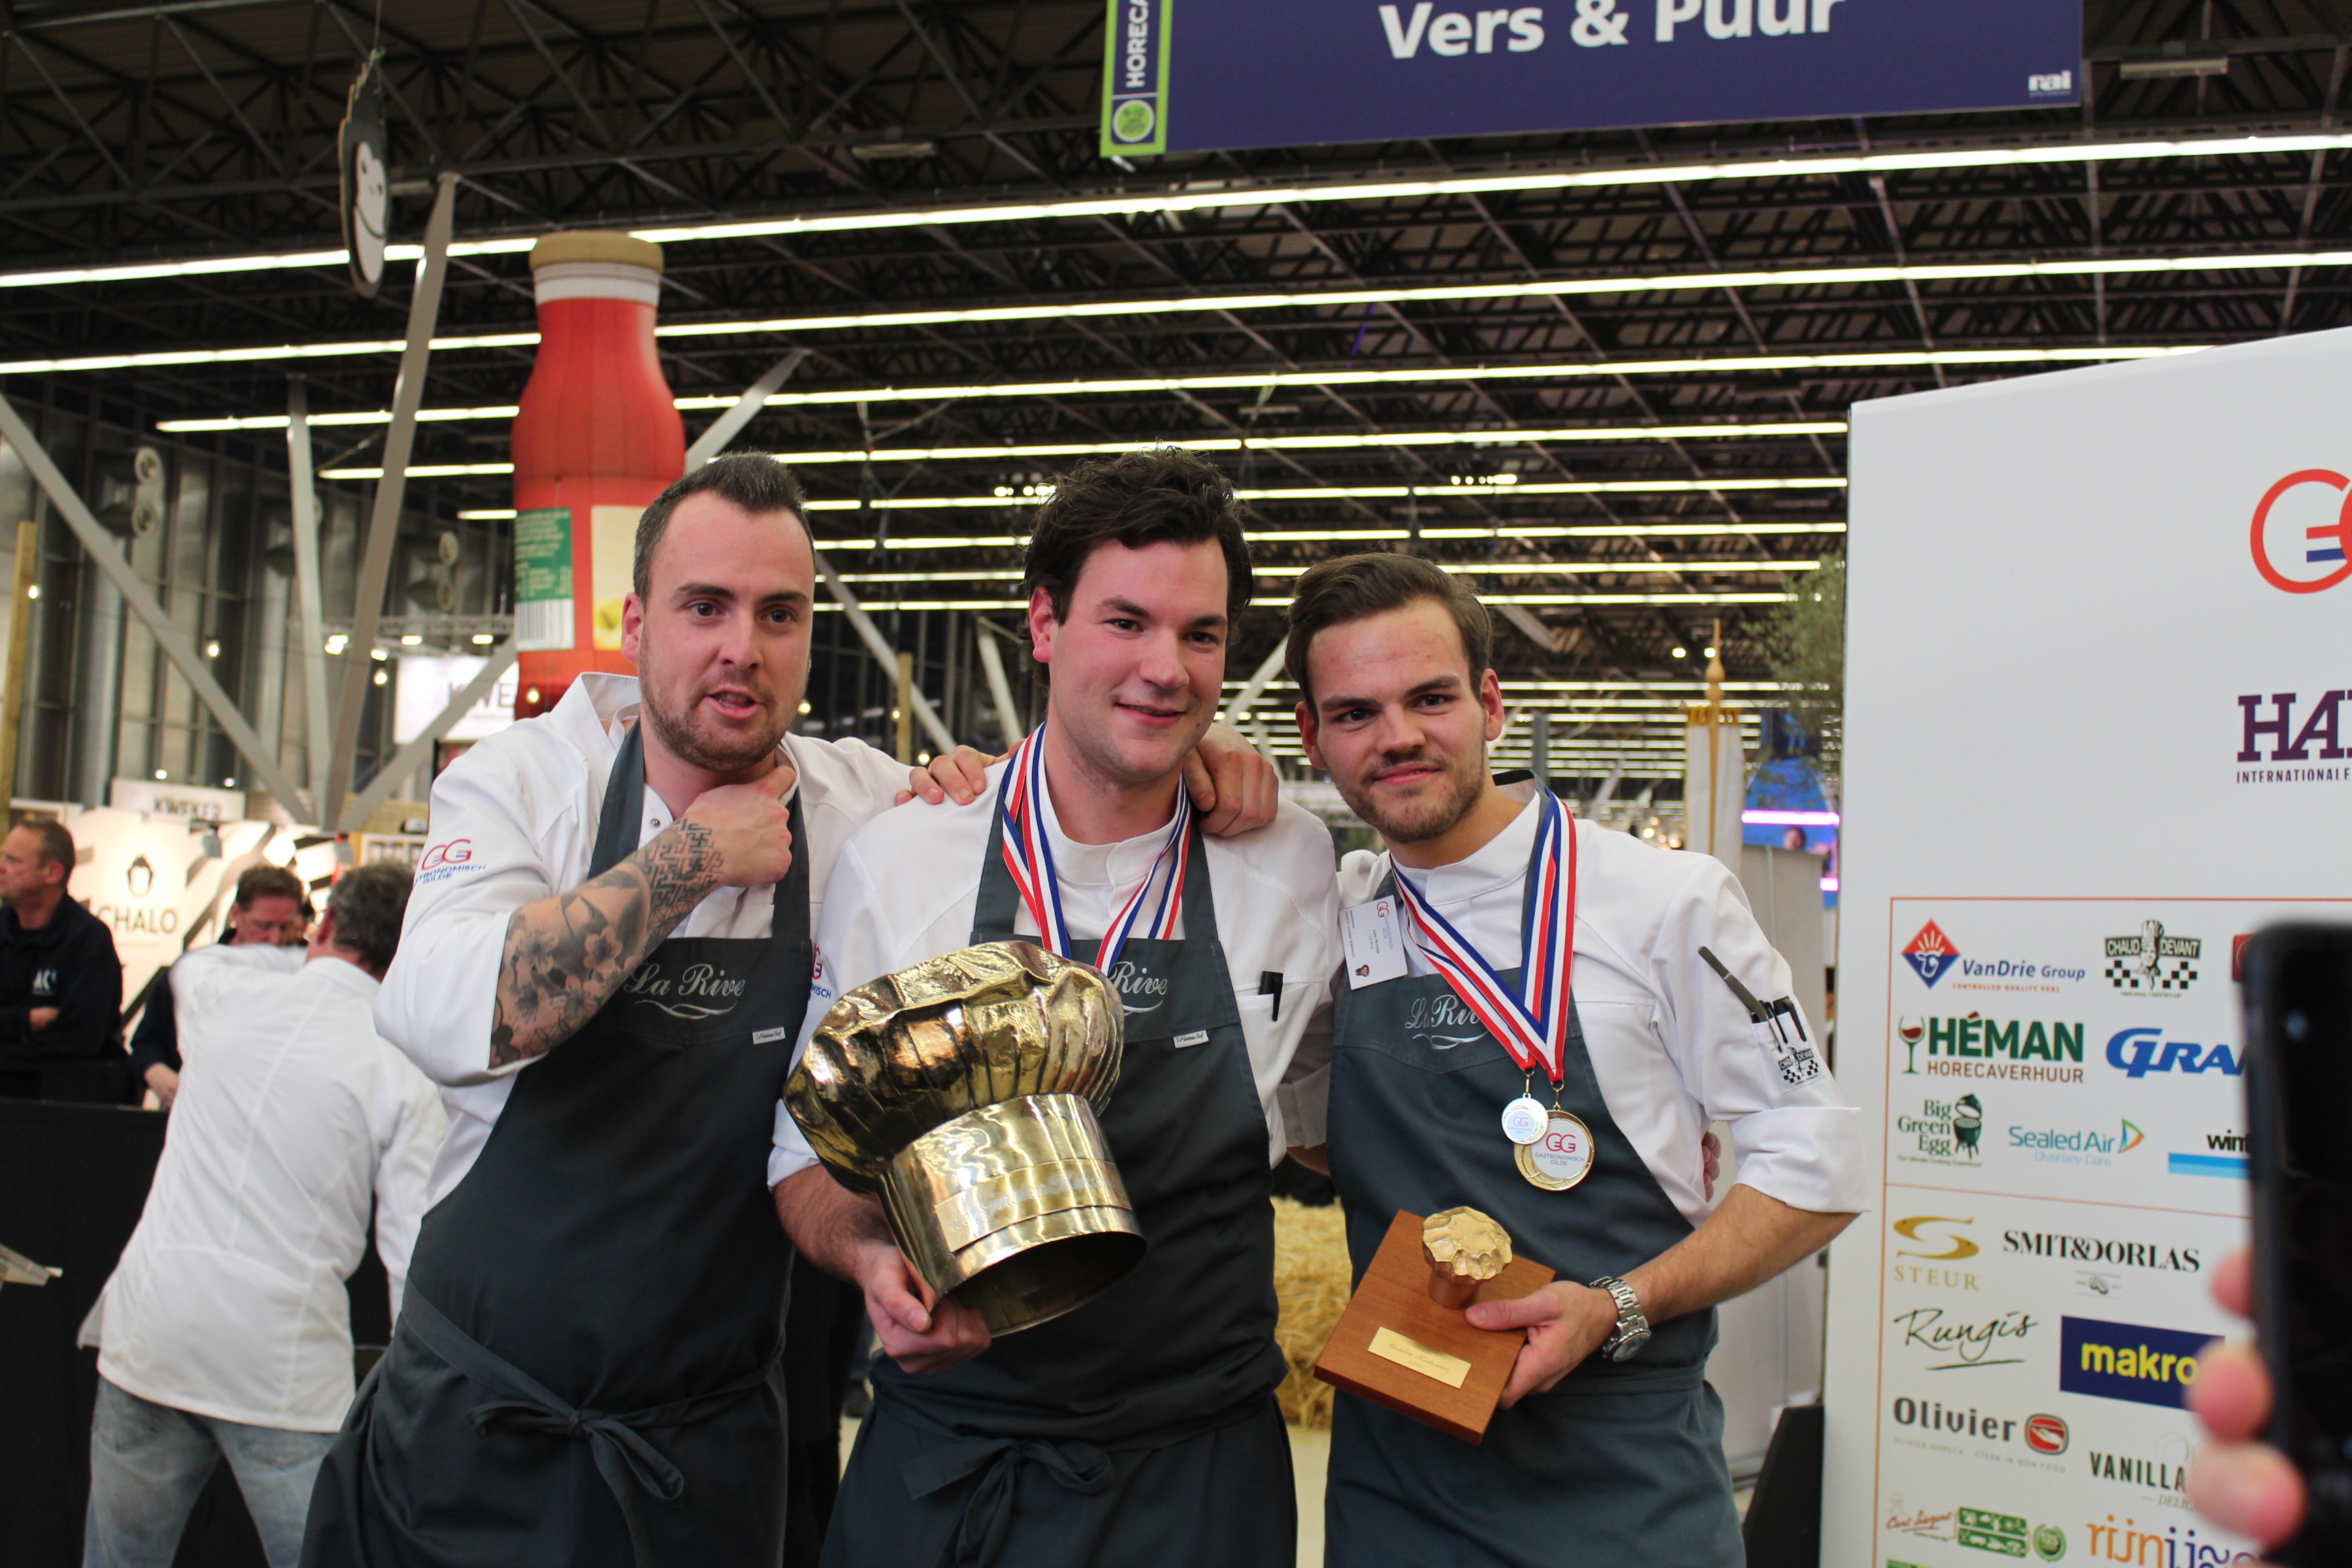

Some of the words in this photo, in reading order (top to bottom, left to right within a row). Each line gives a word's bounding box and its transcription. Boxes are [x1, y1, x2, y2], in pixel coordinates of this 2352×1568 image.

[1379, 1, 1545, 60] Vers
[1569, 0, 1629, 48] &
[1655, 0, 1838, 42] Puur
[2028, 69, 2072, 91] rai
[2238, 689, 2352, 764] HA
[2108, 939, 2140, 956] CHAUD
[2161, 939, 2200, 958] DEVANT
[623, 963, 671, 996] La
[679, 964, 746, 997] Rive
[1963, 960, 2036, 977] VanDrie
[2042, 965, 2086, 981] Group
[1928, 1012, 2084, 1062] HÉMAN
[1927, 1060, 2084, 1083] HORECAVERHUUR
[1923, 1099, 1952, 1122] Big
[1898, 1116, 1951, 1135] Green
[1546, 1132, 1576, 1153] GG
[1918, 1134, 1951, 1157] Egg
[2009, 1126, 2082, 1152] Sealed
[2085, 1132, 2116, 1154] Air
[1535, 1152, 1585, 1162] GASTRONOMISCH
[2034, 1150, 2081, 1166] Diversey
[2085, 1154, 2112, 1166] Care
[1894, 1264, 1980, 1291] STEUR
[1893, 1307, 2039, 1362] Rungis
[2081, 1342, 2199, 1386] makro
[1893, 1396, 2016, 1443] Olivier
[2090, 1451, 2187, 1493] VANILLA
